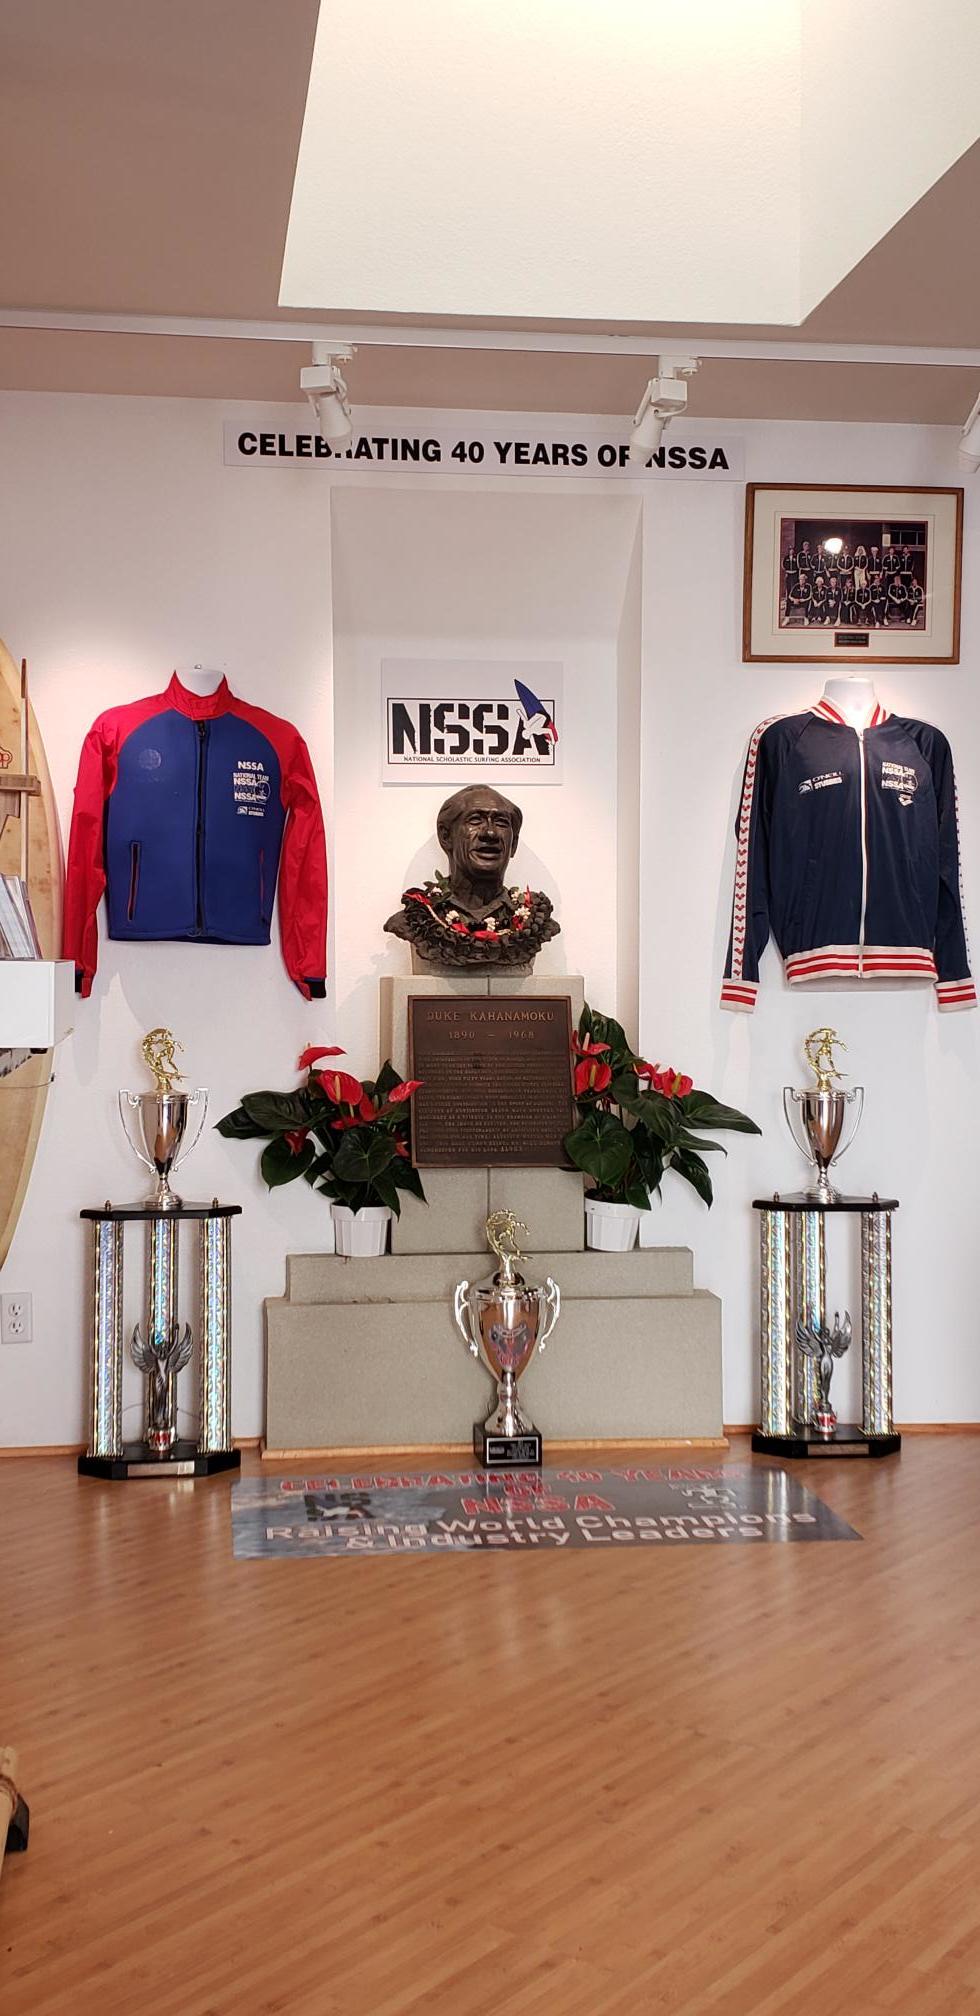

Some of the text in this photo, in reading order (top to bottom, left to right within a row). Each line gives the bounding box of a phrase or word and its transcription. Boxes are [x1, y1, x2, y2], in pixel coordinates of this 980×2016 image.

[451, 441, 485, 463] 40
[493, 441, 588, 466] YEARS
[597, 444, 630, 467] OF
[645, 446, 730, 470] NSSA
[392, 703, 550, 755] NSSA
[237, 761, 264, 771] NSSA
[234, 778, 258, 787] NSSA
[234, 792, 257, 801] NSSA
[427, 1011, 554, 1021] DUKE KAHANAMOKU
[449, 1031, 475, 1039] 1890
[508, 1031, 535, 1039] 1968
[460, 1493, 616, 1515] NSSA
[266, 1511, 817, 1540] Raising World Champions
[346, 1525, 764, 1549] & Industry Leaders
